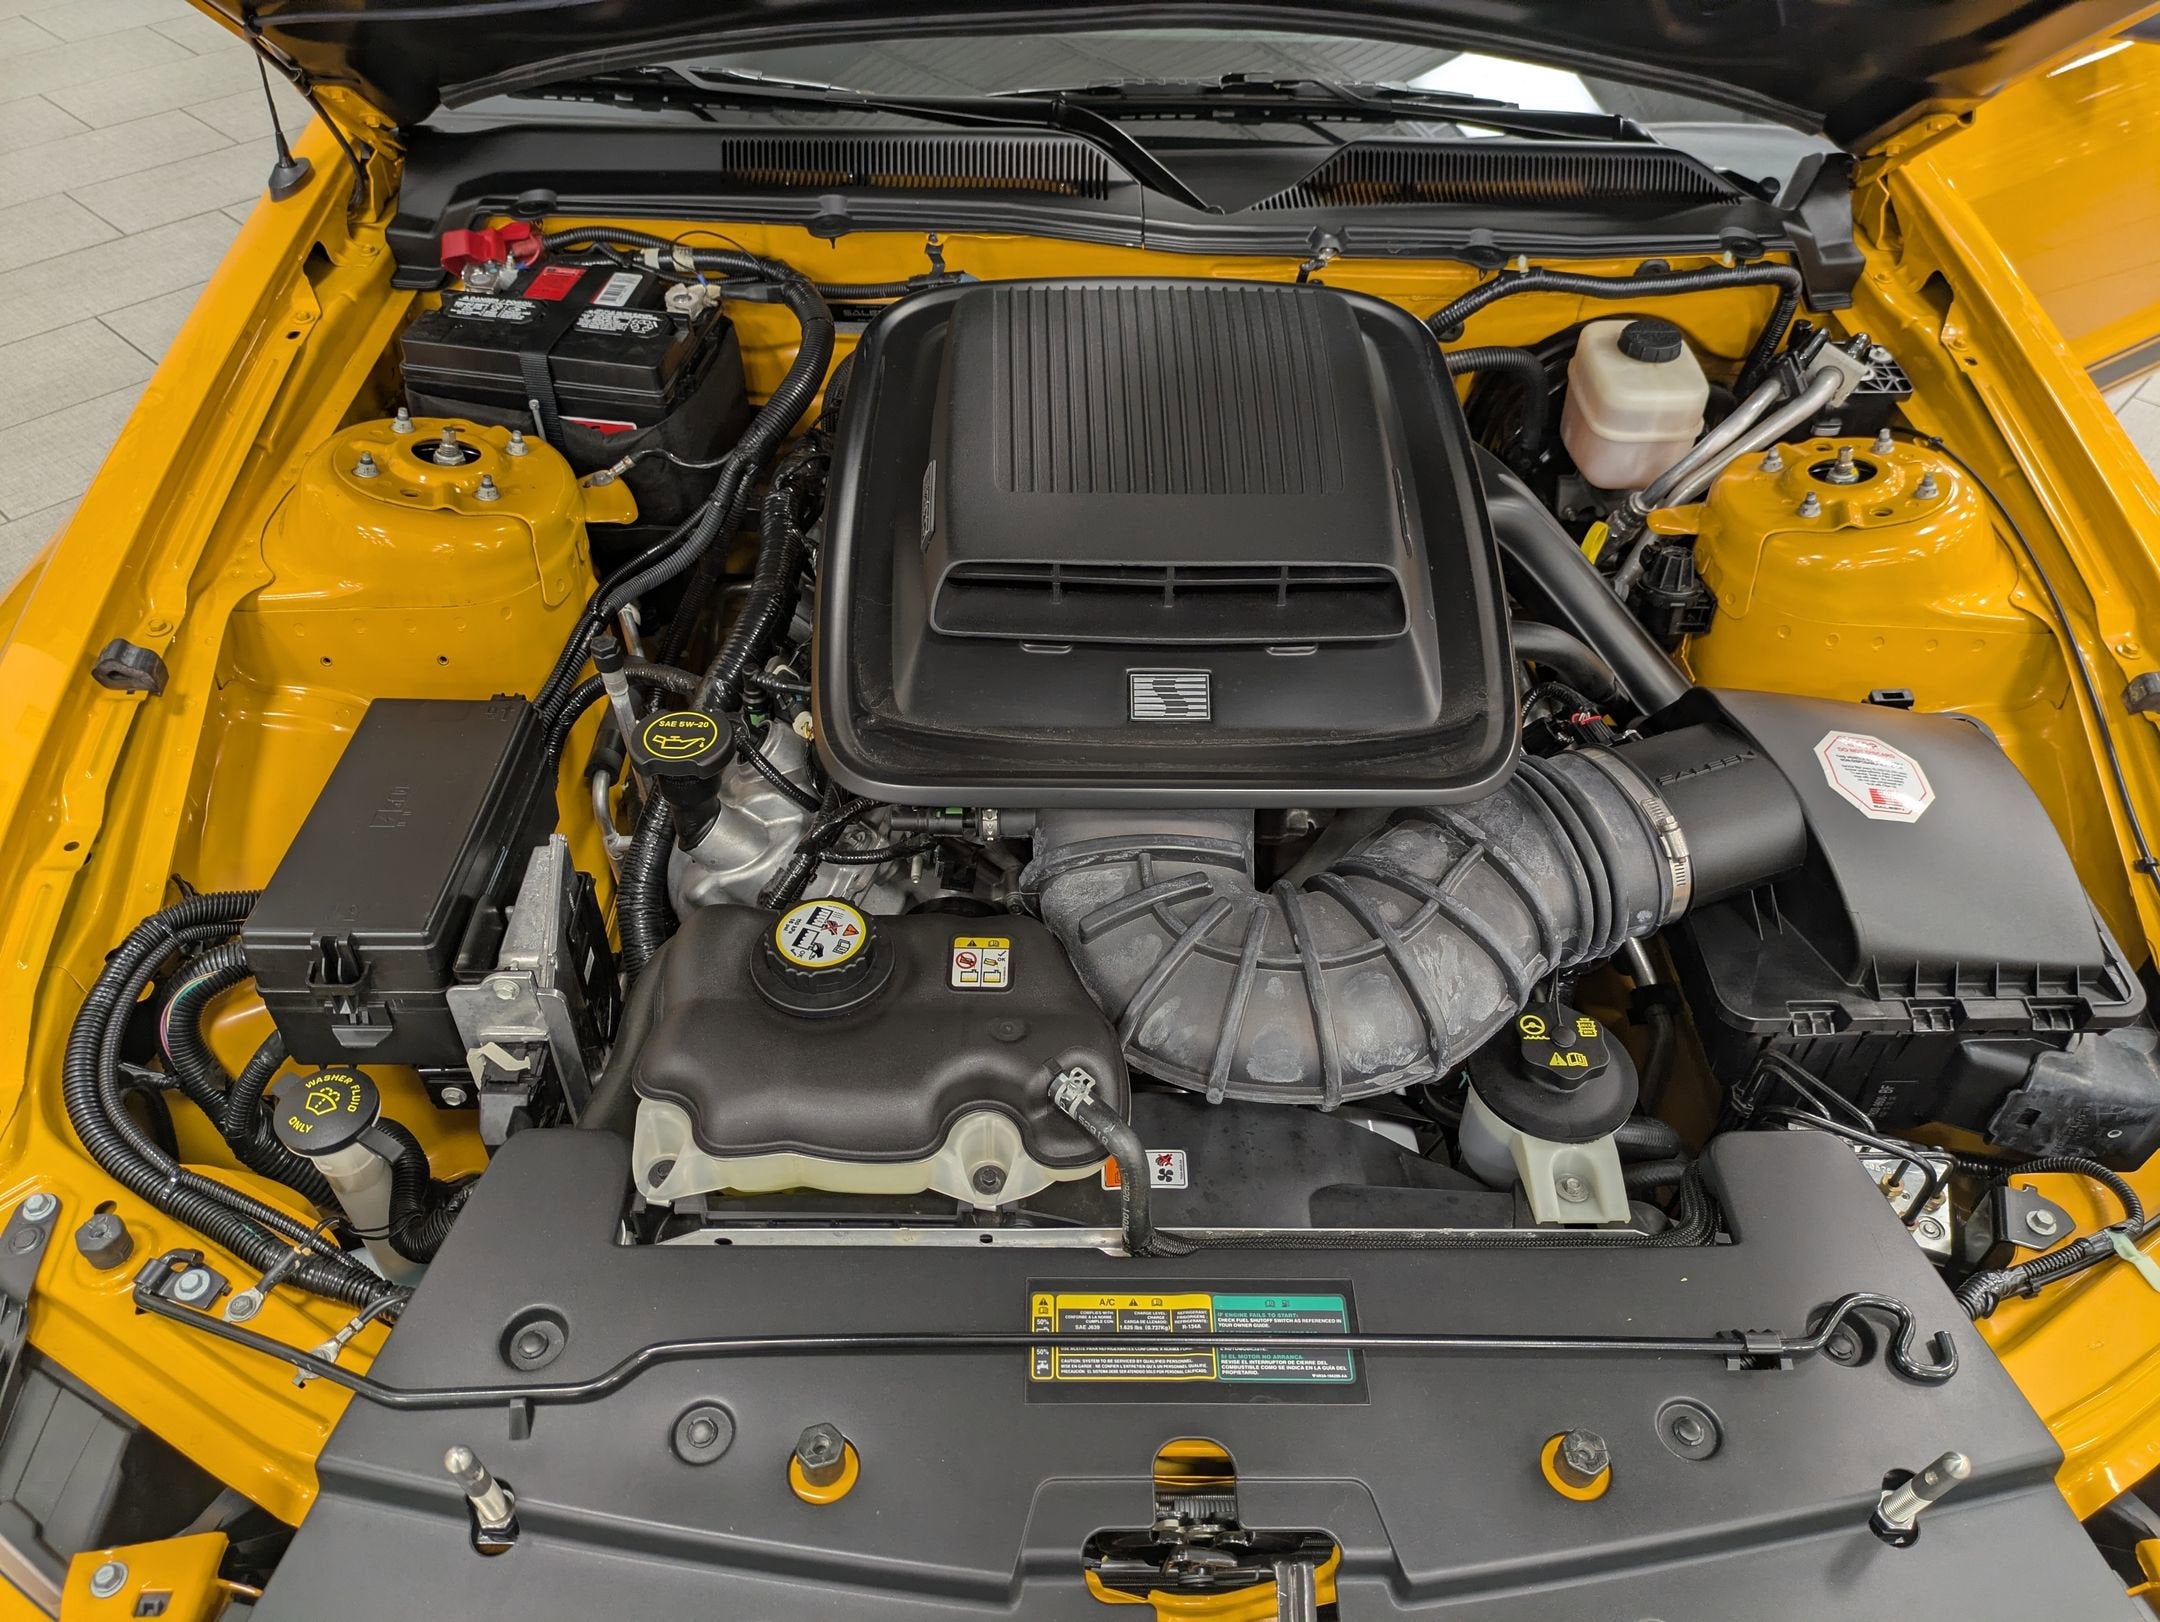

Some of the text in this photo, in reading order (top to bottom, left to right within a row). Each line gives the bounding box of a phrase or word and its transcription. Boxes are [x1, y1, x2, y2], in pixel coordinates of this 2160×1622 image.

[659, 720, 710, 729] SAE 5W-20
[305, 1074, 361, 1113] WASHER FLUID
[288, 1116, 314, 1134] ONLY
[1099, 1298, 1115, 1306] A/C
